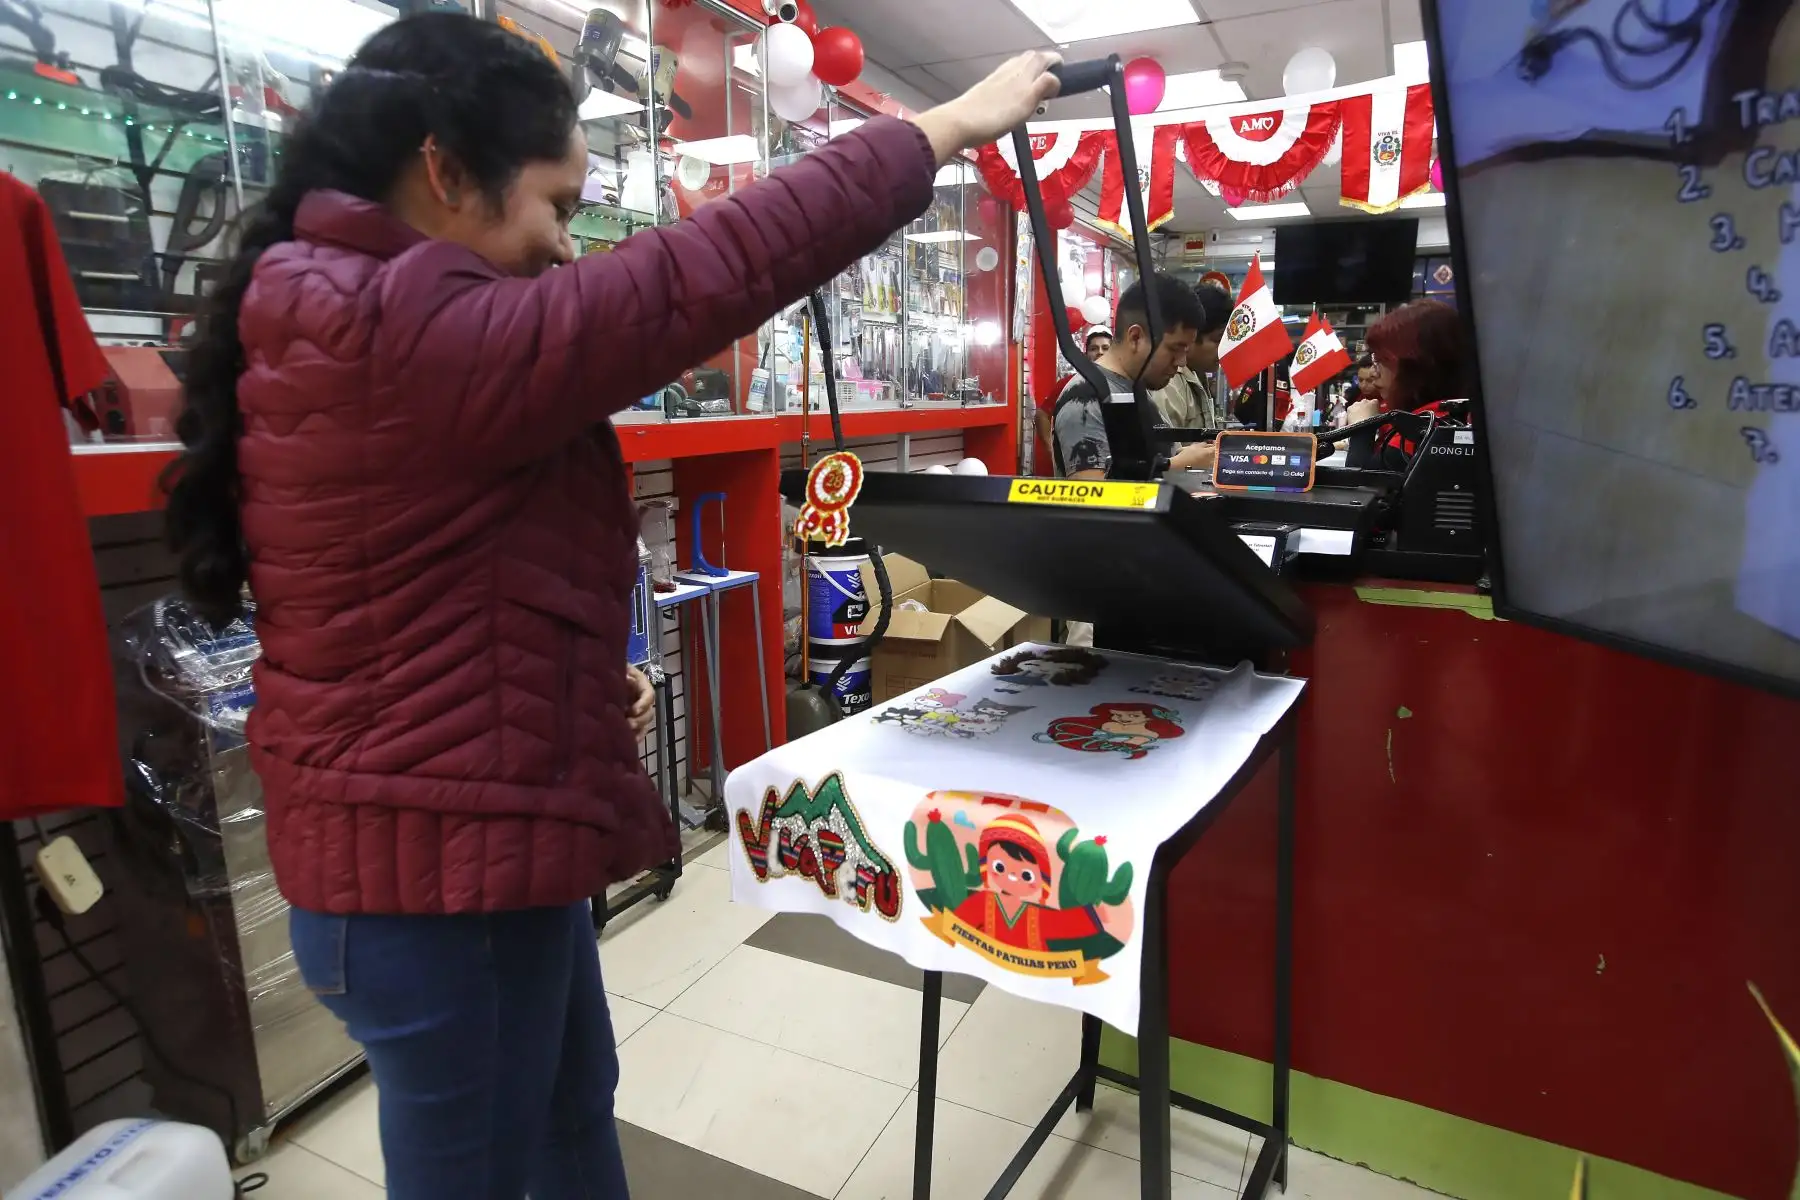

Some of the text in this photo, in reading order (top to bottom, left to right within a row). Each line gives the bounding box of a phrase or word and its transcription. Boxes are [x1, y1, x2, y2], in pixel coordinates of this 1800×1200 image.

[1743, 146, 1800, 190] CA
[1769, 317, 1800, 358] A
[1245, 444, 1286, 452] Aceptamos
[1430, 446, 1463, 456] DONG
[1230, 455, 1250, 463] VISA
[1018, 483, 1104, 498] CAUTION
[951, 923, 995, 955] FIESTAS
[996, 949, 1045, 969] PATRIAS
